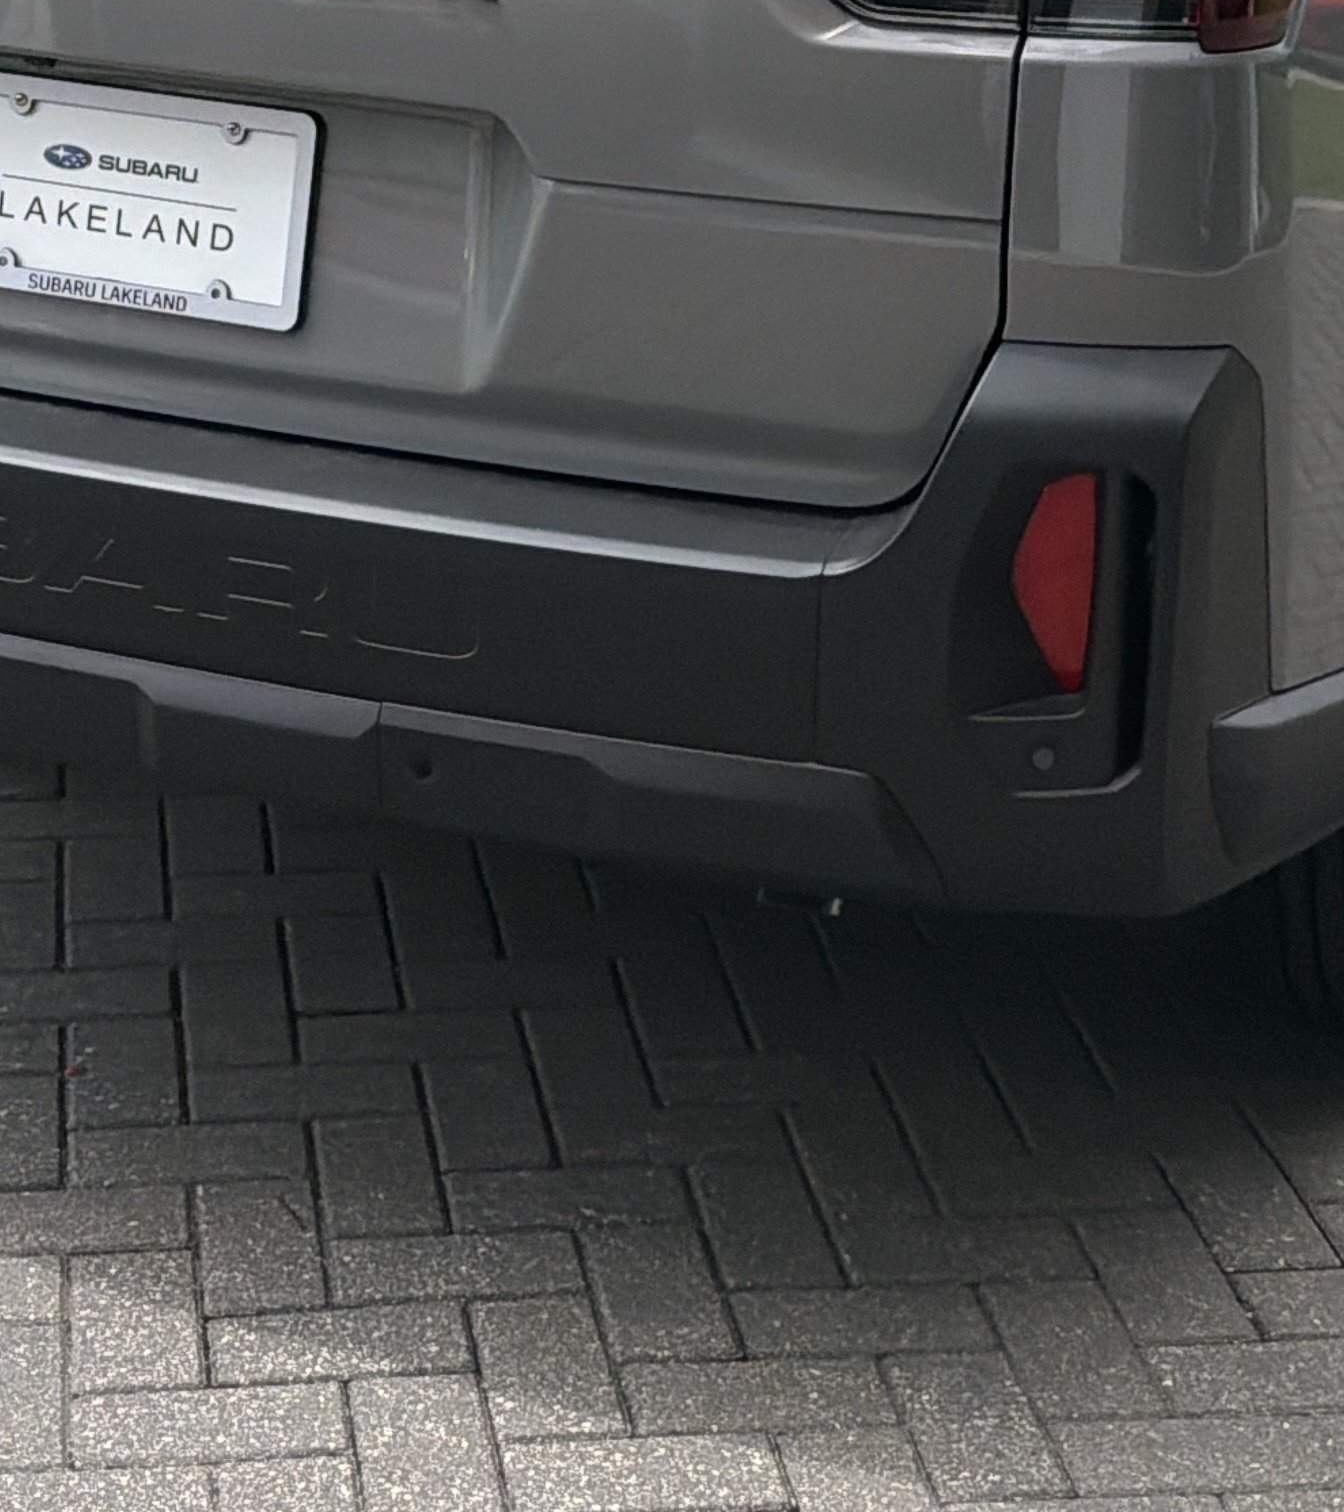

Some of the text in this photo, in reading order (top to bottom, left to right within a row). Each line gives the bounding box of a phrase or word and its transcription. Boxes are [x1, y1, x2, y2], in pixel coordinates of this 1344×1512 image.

[98, 154, 198, 184] SUBARU
[27, 272, 188, 313] SUBARU LAKELAND
